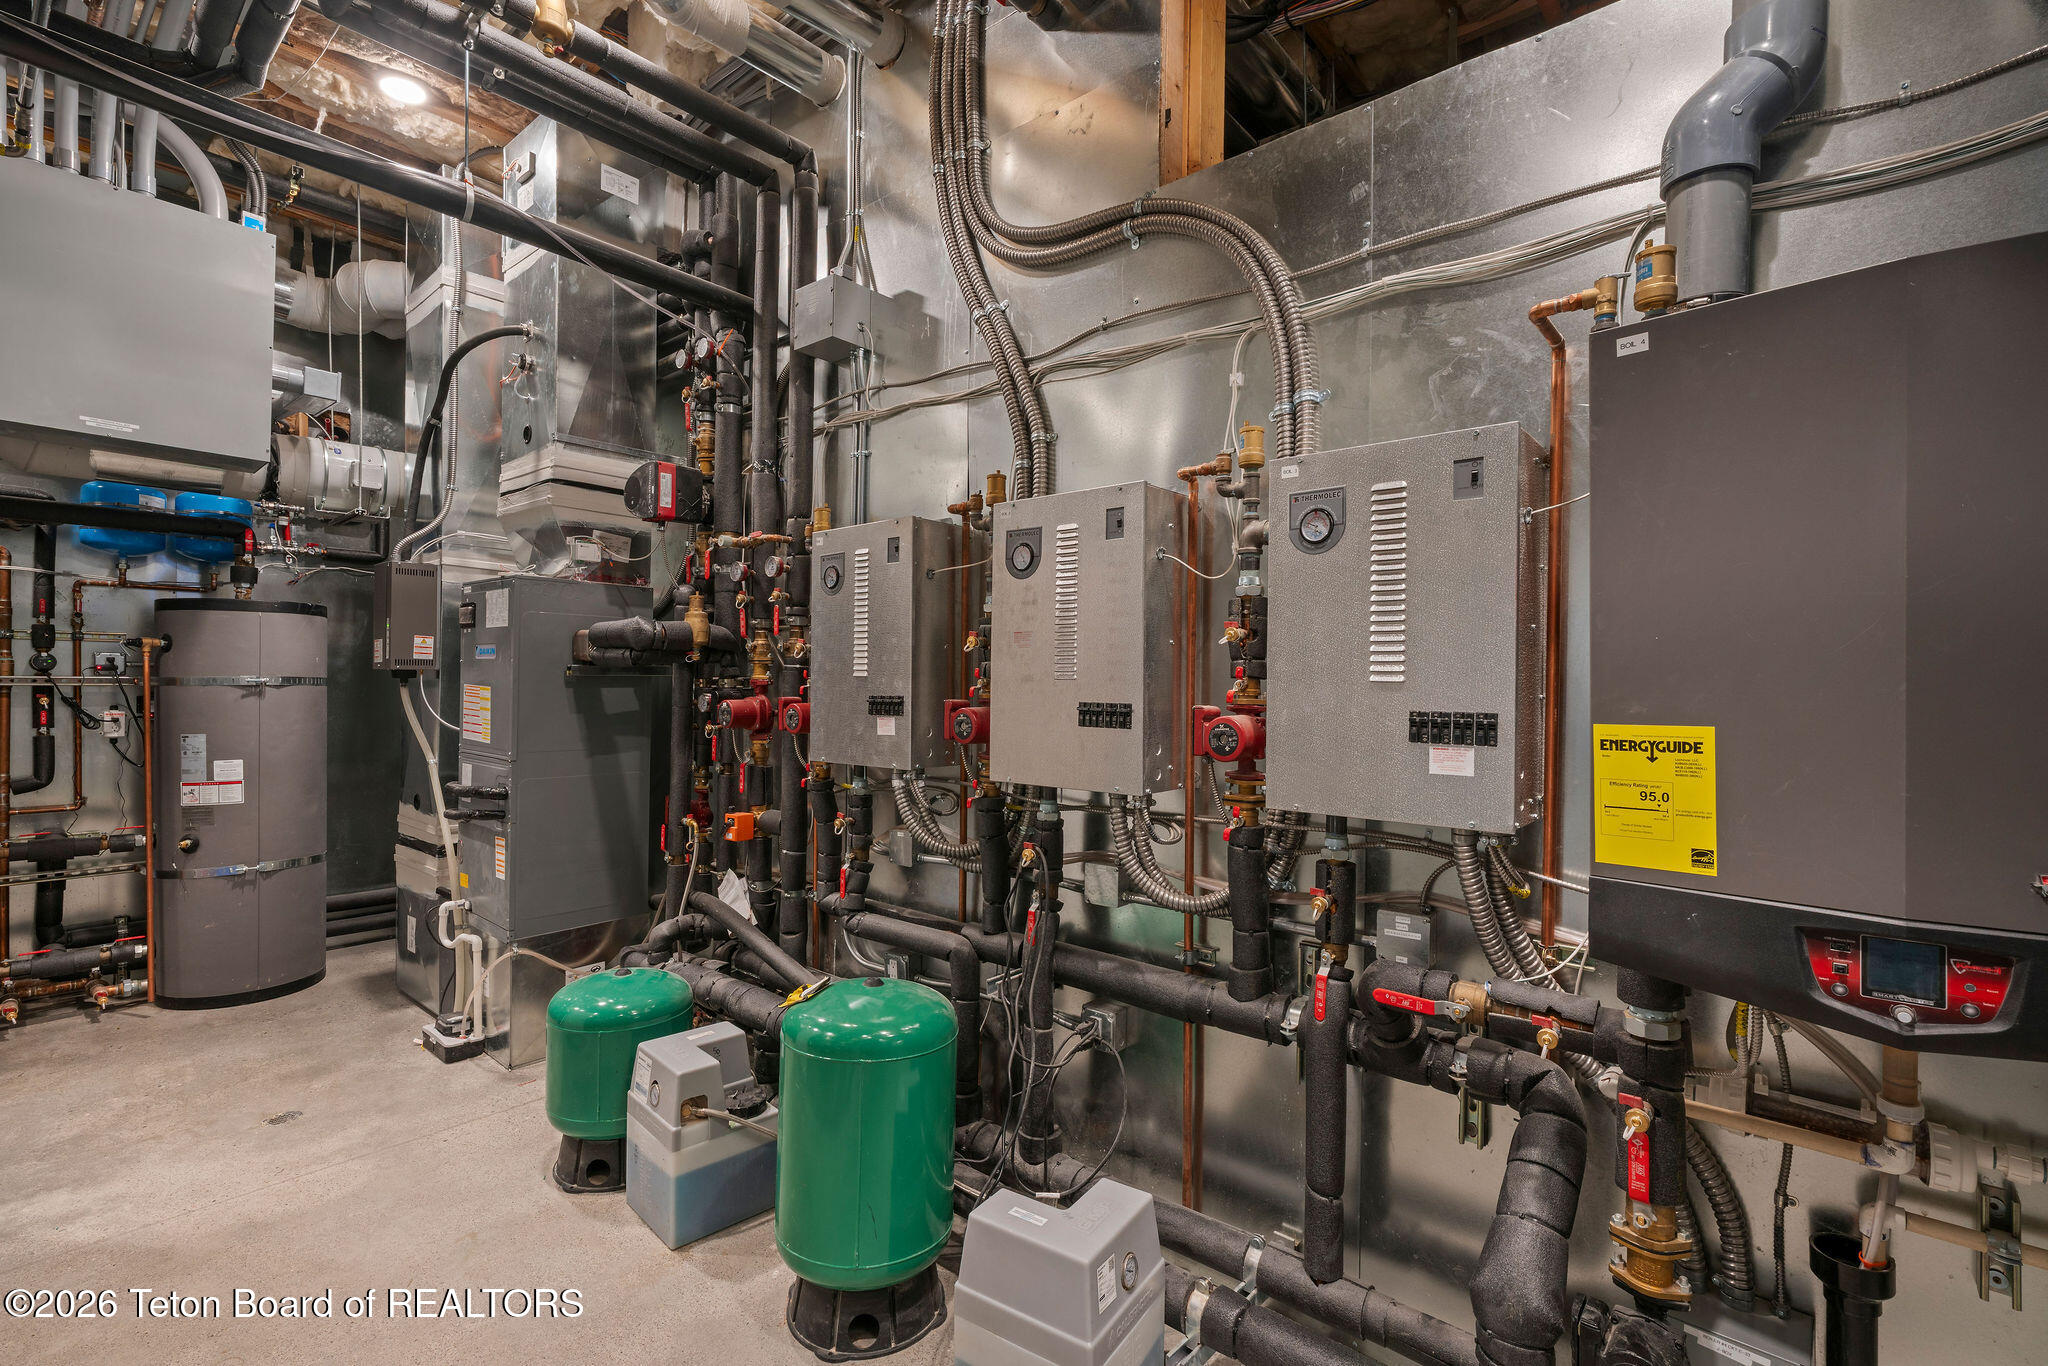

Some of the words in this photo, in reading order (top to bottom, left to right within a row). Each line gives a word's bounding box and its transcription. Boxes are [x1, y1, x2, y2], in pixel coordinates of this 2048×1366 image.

[1301, 490, 1342, 502] THERMOLEC
[1599, 738, 1704, 757] ENERGYGUIDE
[1609, 781, 1633, 789] Efficiency
[1639, 790, 1670, 803] 95.0
